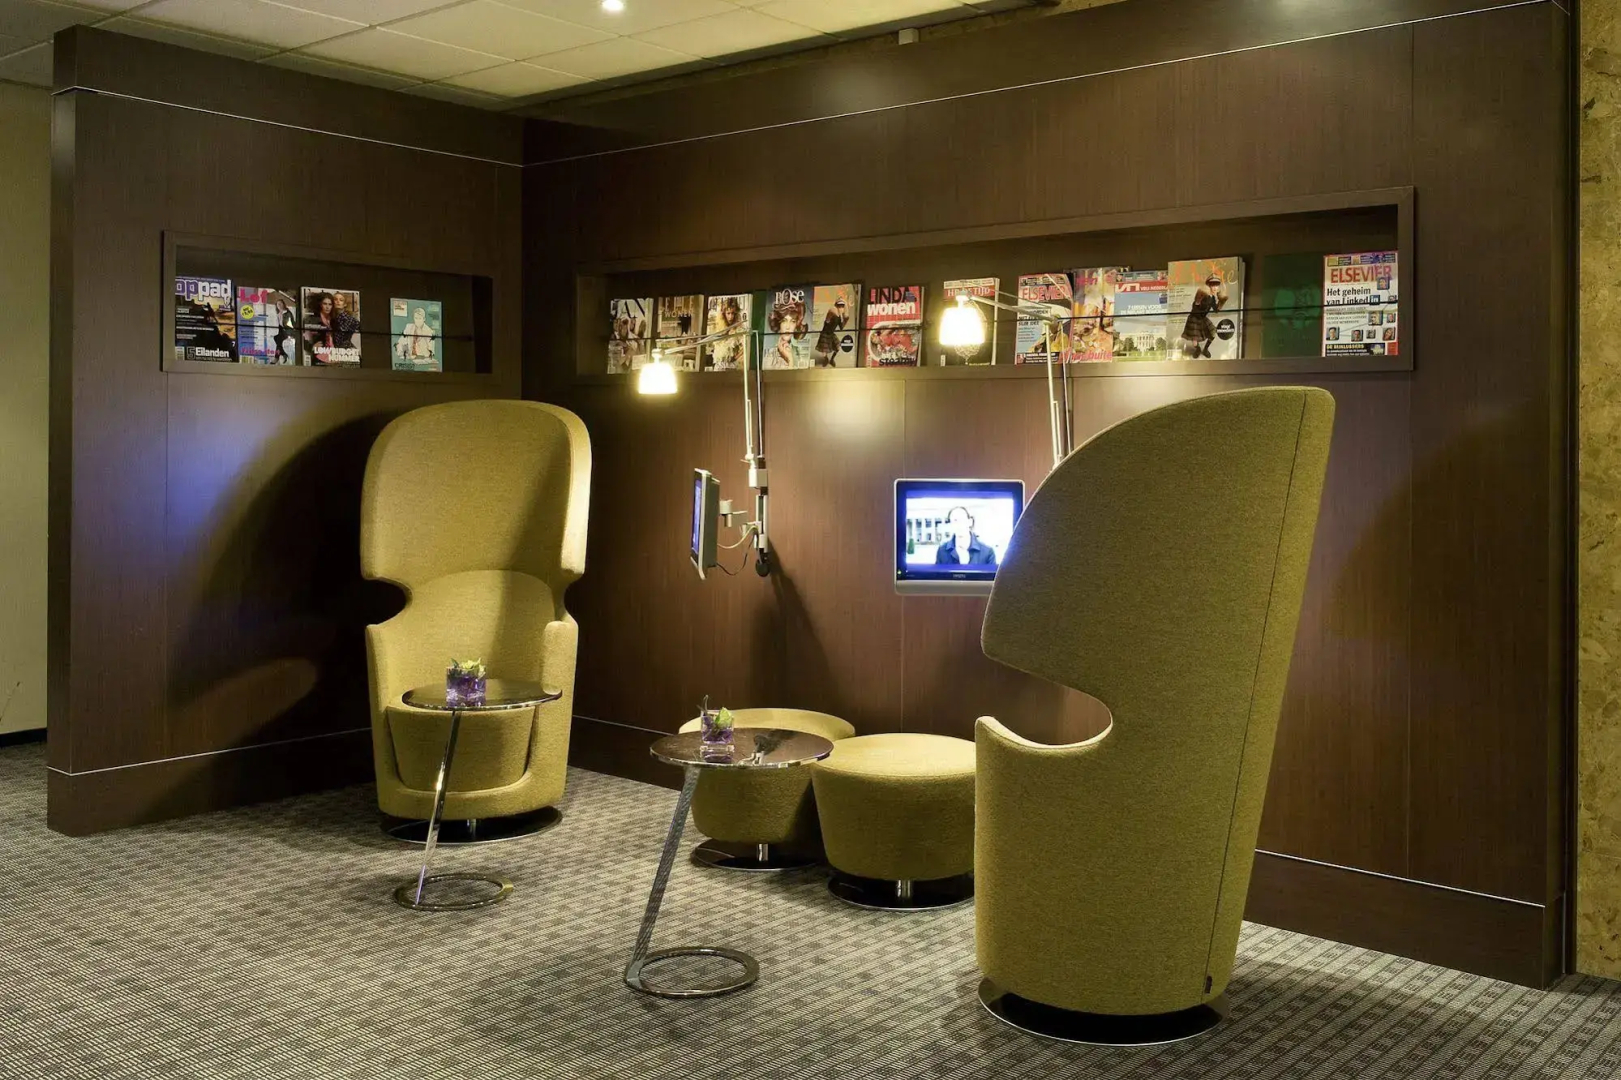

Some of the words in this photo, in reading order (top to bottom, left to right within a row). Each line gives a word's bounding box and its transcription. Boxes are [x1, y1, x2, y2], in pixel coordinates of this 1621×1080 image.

[1331, 265, 1392, 284] ELSEVIER
[1327, 287, 1341, 296] Het
[1342, 286, 1371, 297] geheim
[867, 302, 916, 316] wonen
[195, 347, 229, 358] Eilanden
